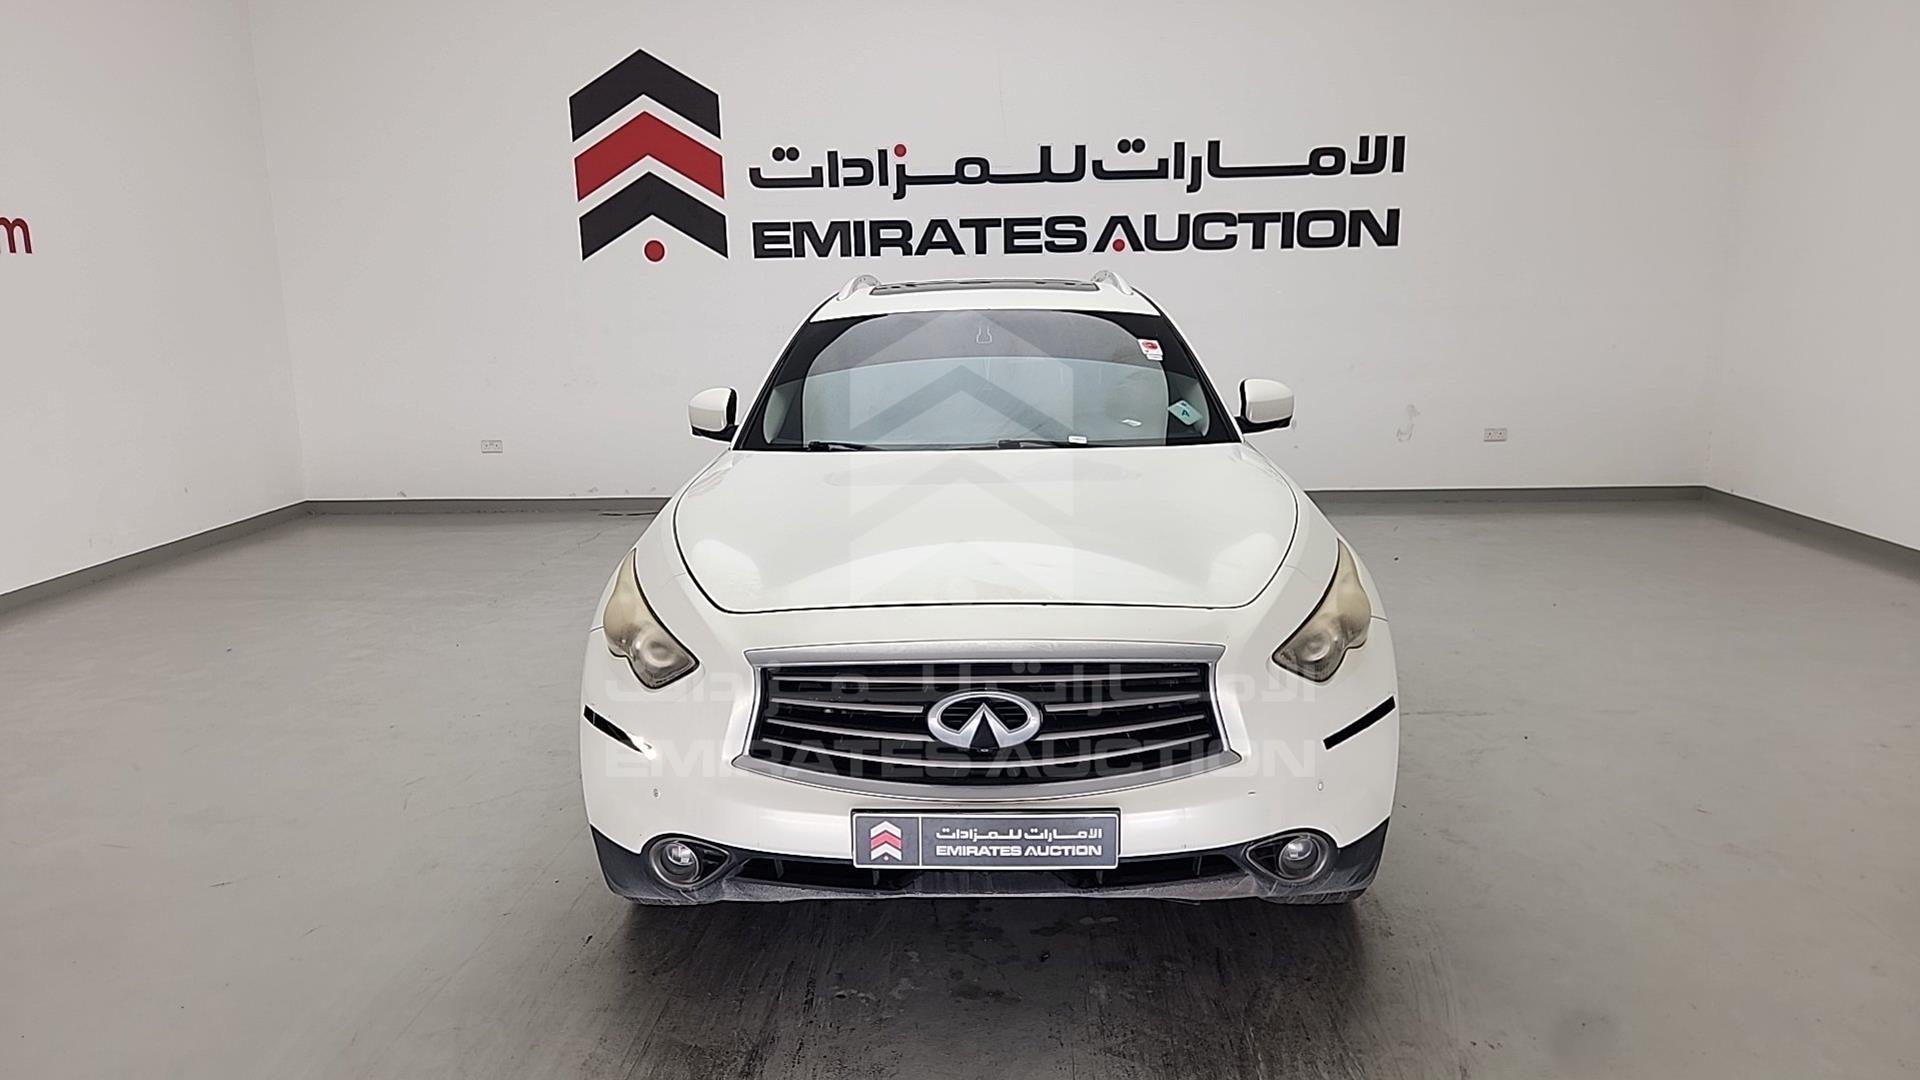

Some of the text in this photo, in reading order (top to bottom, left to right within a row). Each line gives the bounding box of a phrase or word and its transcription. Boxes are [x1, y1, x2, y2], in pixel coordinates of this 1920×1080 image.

[749, 143, 1087, 200] للمزادات
[752, 208, 1400, 258] EMIRATES AUCTION
[936, 845, 1103, 857] EMIRATES AUCTION
